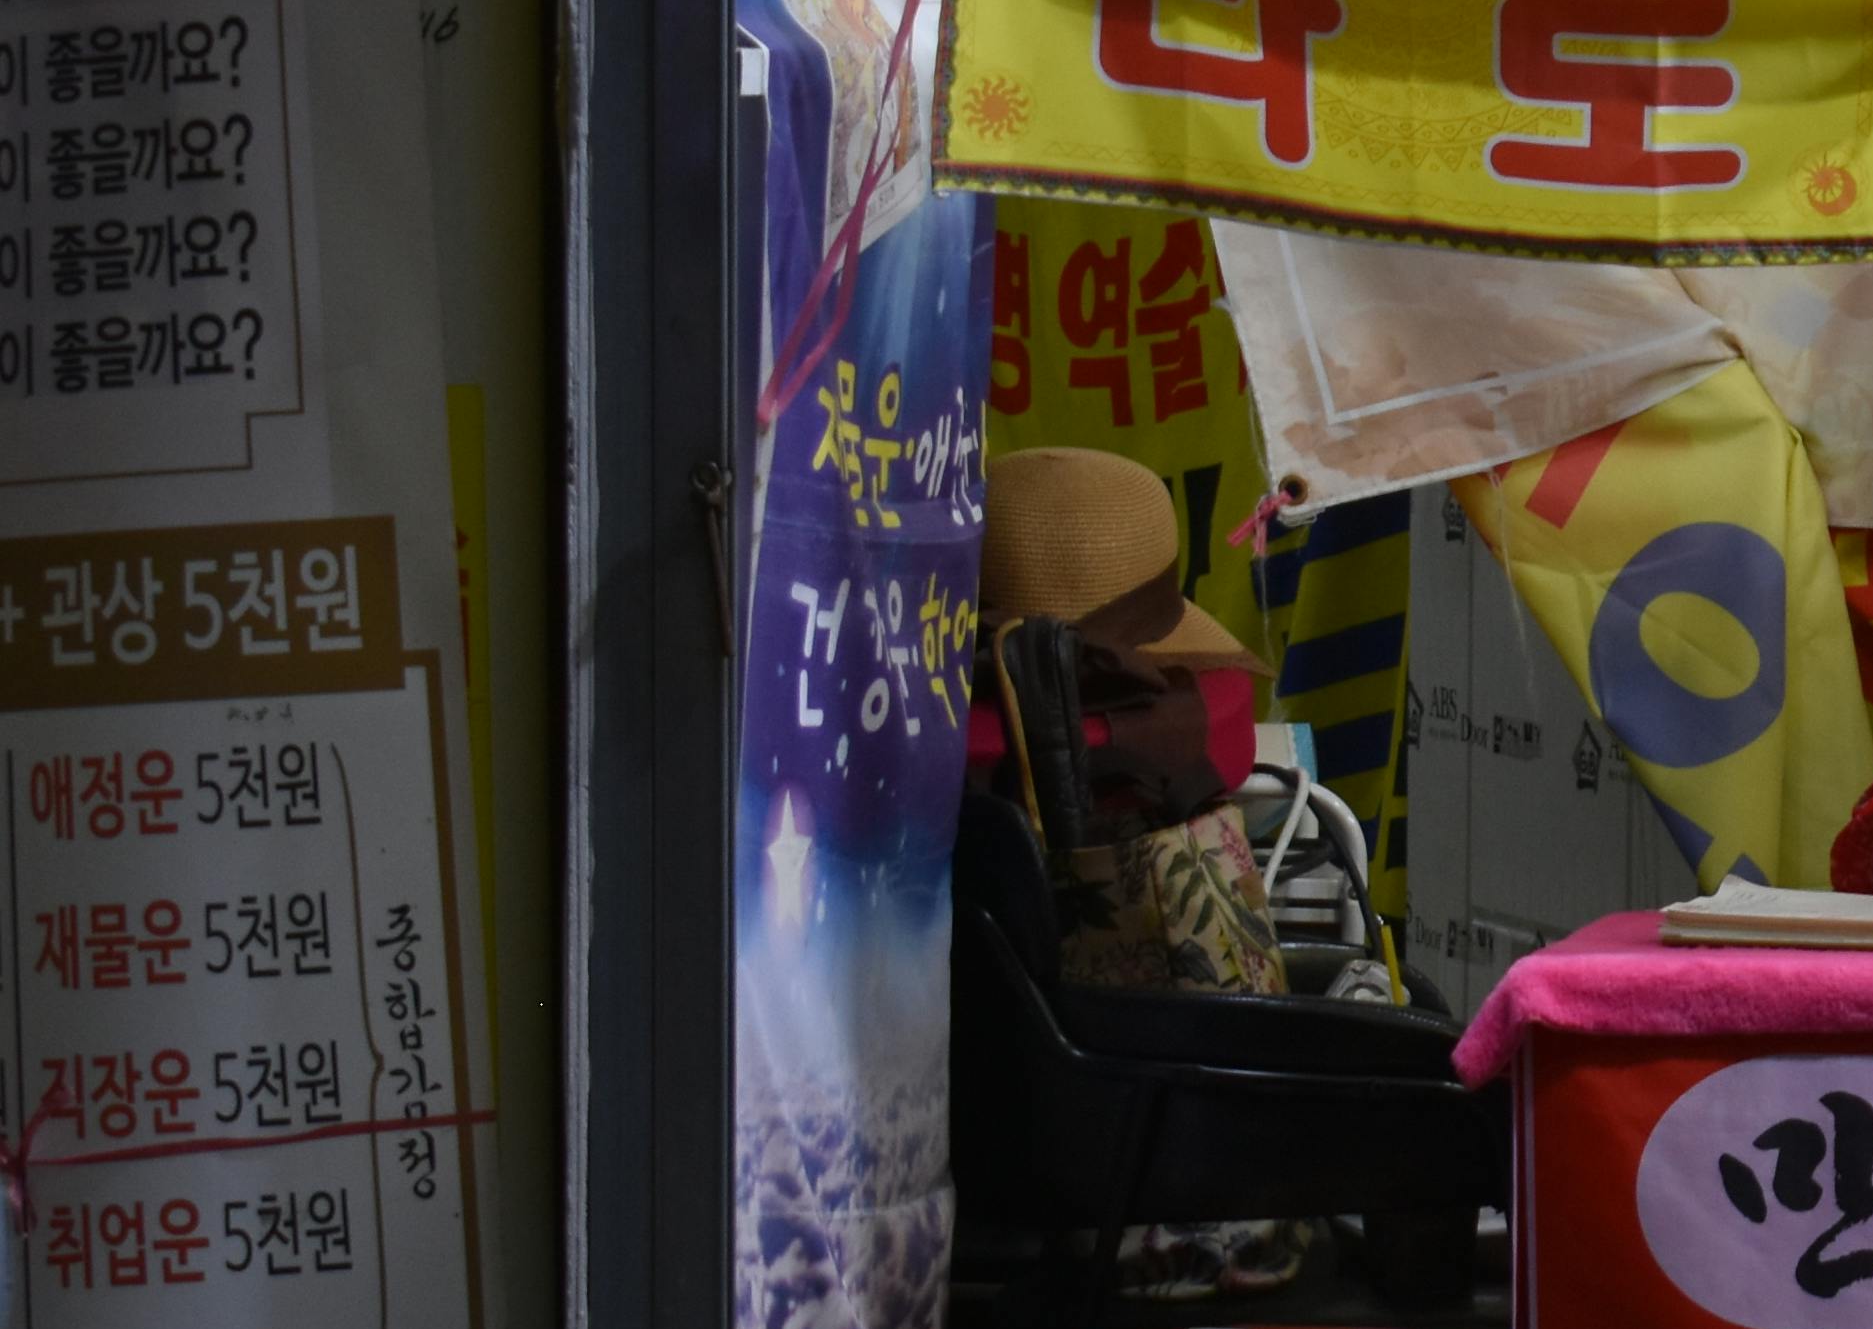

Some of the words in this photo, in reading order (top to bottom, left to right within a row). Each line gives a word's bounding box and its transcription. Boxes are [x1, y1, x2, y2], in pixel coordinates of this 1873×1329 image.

[45, 16, 247, 103] 좋을까요?
[47, 114, 252, 201] 좋을까요?
[49, 211, 257, 297] 좋을까요?
[50, 308, 263, 394] 좋을까요?
[41, 556, 164, 667] 관상
[182, 544, 363, 656] 5천원
[30, 750, 183, 839] 애정운
[196, 741, 322, 829] 5천원
[35, 899, 191, 989] 재물운
[205, 891, 332, 979] 5천원
[41, 1049, 200, 1139] 직장운
[215, 1040, 342, 1128] 5천원
[46, 1198, 209, 1288] 취업운
[223, 1188, 353, 1275] 5천원
